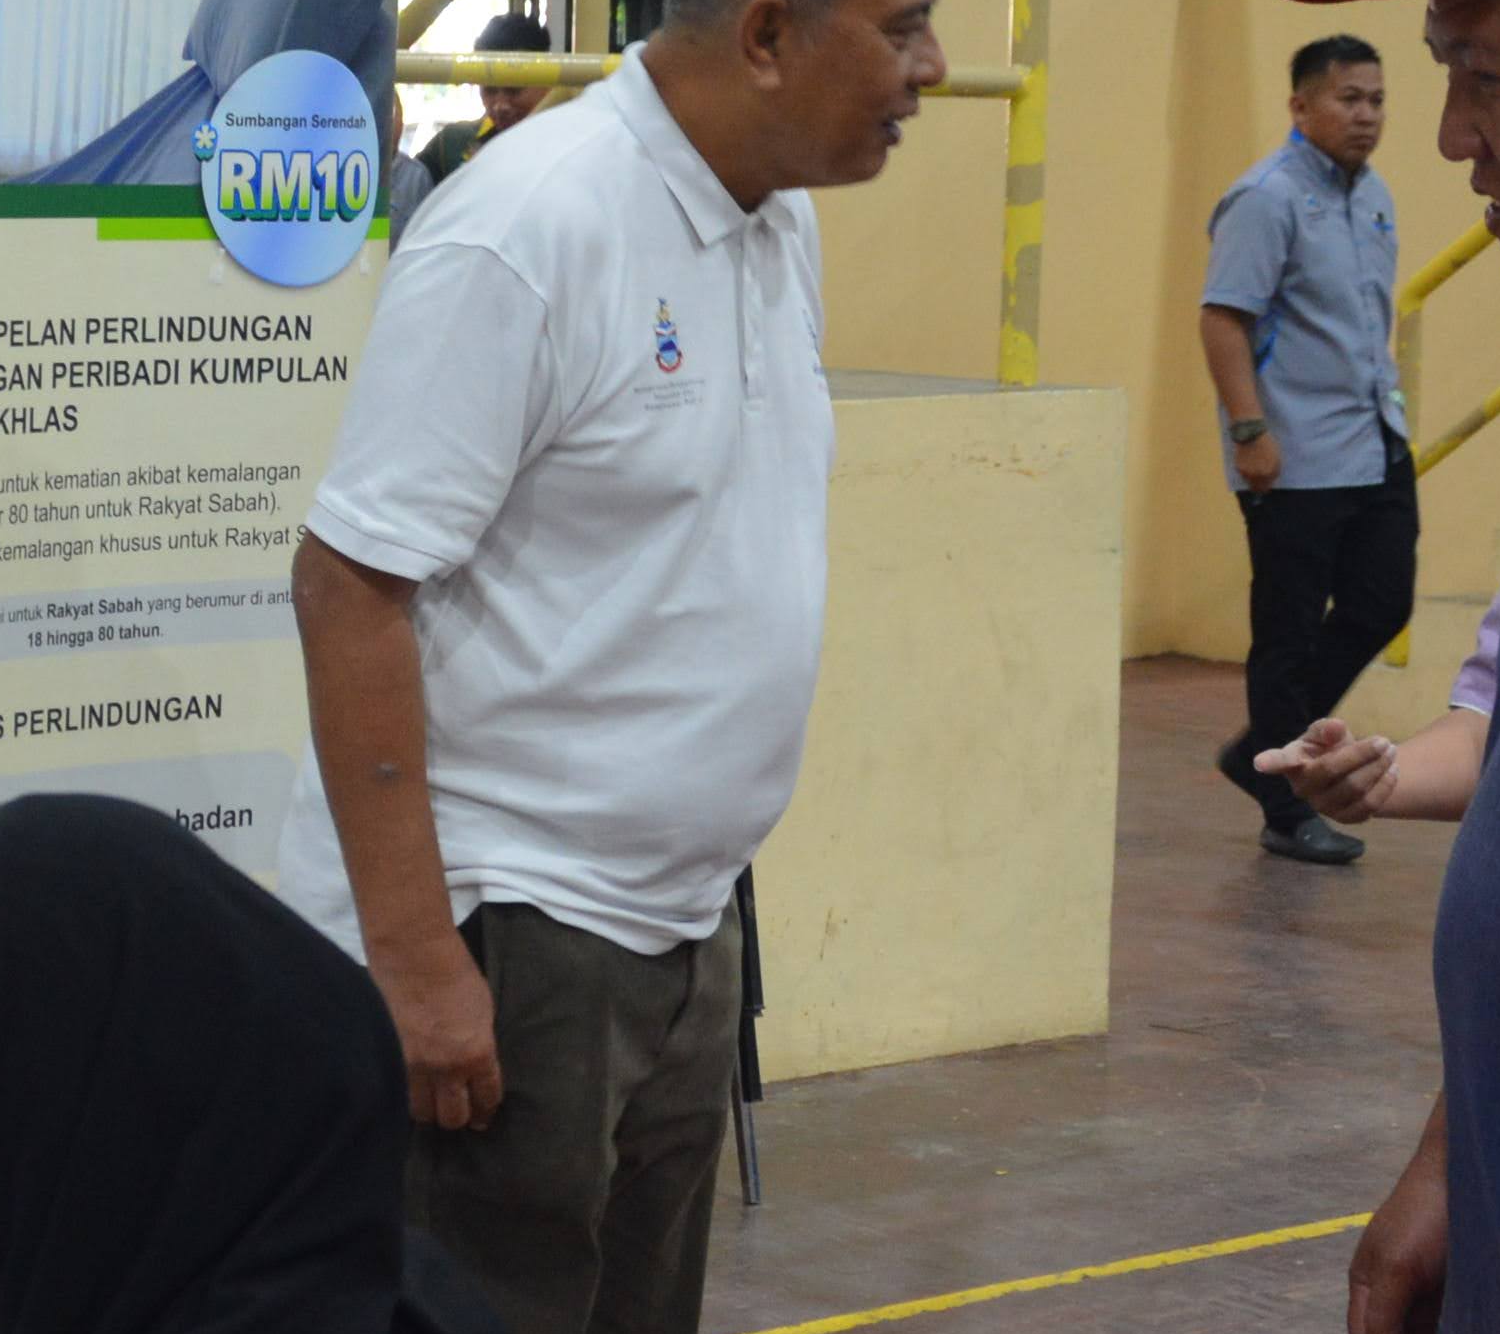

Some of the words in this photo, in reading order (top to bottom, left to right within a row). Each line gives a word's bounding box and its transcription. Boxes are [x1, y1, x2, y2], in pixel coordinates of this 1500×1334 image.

[225, 113, 308, 131] Sumbangan
[311, 114, 367, 130] Serendah
[217, 148, 371, 222] RM10
[85, 314, 313, 345] PERLINDUNGAN
[52, 358, 180, 389] PERIBADI
[190, 355, 349, 385] KUMPULAN
[44, 467, 122, 490] kematian
[127, 465, 181, 486] akibat
[187, 463, 301, 487] kemalangan
[8, 503, 29, 525] 80
[33, 501, 80, 523] tahun
[84, 498, 133, 520] untuk
[138, 494, 202, 522] Rakyat
[208, 490, 282, 515] Sabah).
[100, 532, 162, 554] khusus
[167, 528, 218, 549] untuk
[224, 525, 291, 551] Rakyat
[8, 604, 43, 623] untuk
[46, 600, 95, 621] Rakyat
[98, 596, 143, 615] Sabah
[147, 596, 182, 615] yang
[185, 590, 246, 611] berumur
[250, 589, 263, 605] di
[27, 632, 43, 648] 18
[46, 627, 94, 649] hingga
[98, 625, 115, 642] 80
[119, 622, 164, 641] tahun.
[13, 694, 223, 738] PERLINDUNGAN
